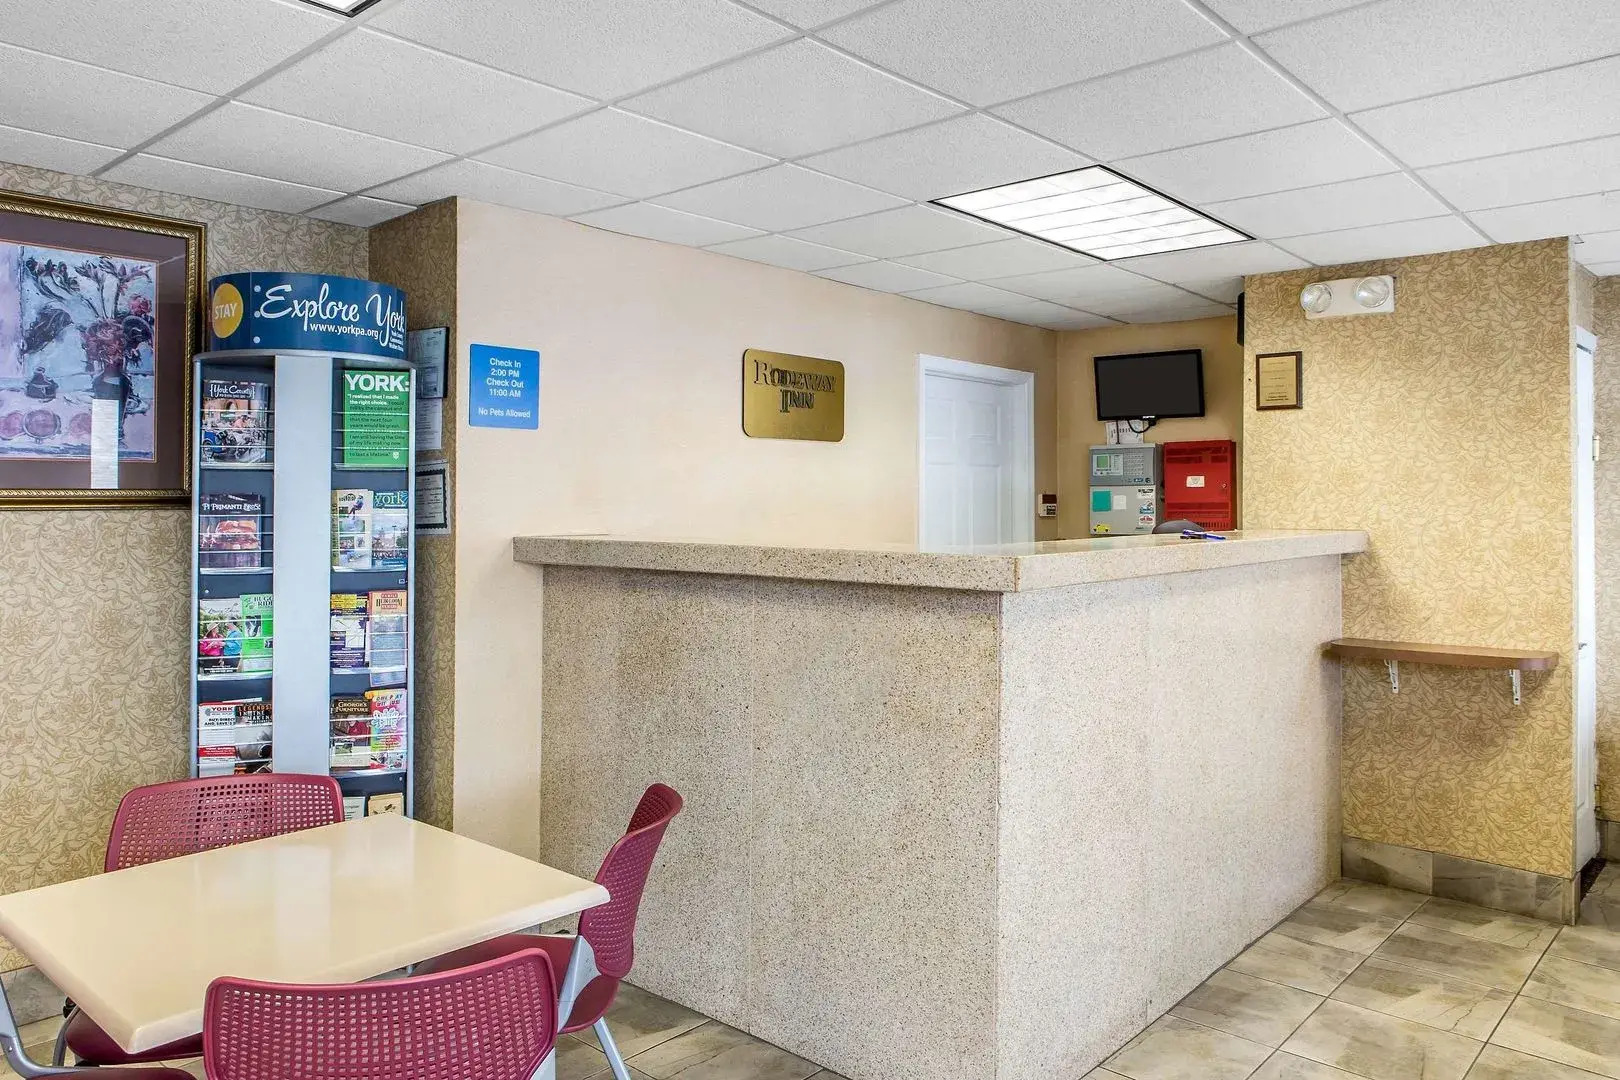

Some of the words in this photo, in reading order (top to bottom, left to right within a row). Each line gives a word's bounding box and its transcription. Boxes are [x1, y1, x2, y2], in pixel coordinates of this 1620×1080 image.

[214, 304, 238, 320] STAY
[260, 283, 360, 332] Explore
[366, 294, 404, 347] York
[310, 322, 378, 340] www.yorkpa.org
[490, 358, 512, 367] Check
[490, 368, 506, 376] 2:00
[508, 370, 520, 378] PM
[754, 360, 836, 392] RODEWAY
[345, 374, 409, 392] YORK:
[486, 378, 510, 387] Check
[511, 380, 524, 388] Out
[780, 389, 814, 413] INN
[489, 408, 504, 416] Pets
[505, 409, 530, 418] Allowed
